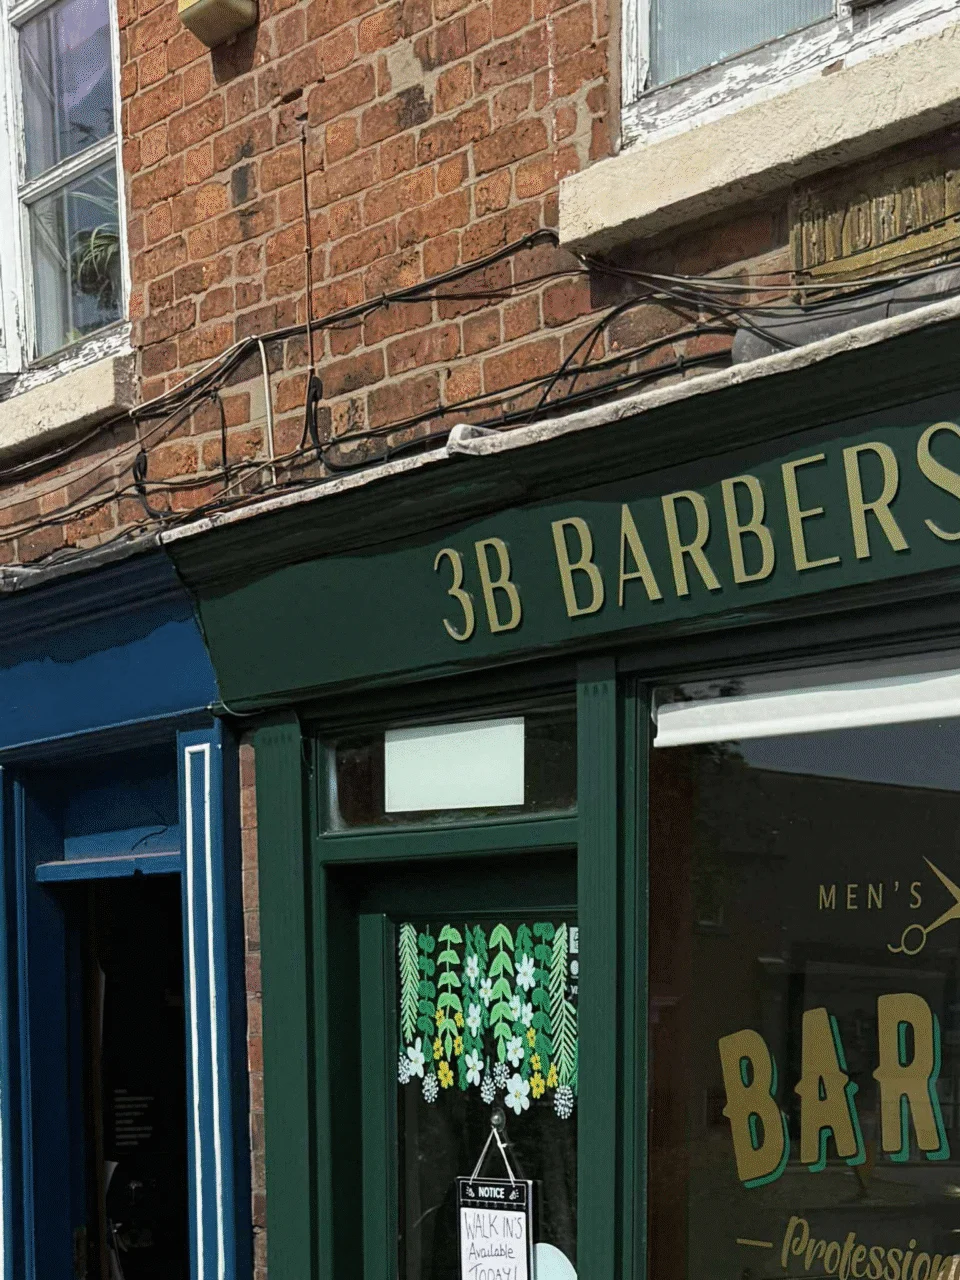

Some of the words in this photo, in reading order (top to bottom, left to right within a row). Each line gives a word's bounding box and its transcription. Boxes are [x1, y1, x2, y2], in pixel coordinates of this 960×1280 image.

[433, 537, 522, 642] 3B
[818, 881, 923, 911] MEN'S
[478, 1186, 505, 1199] NOTICE
[464, 1211, 499, 1241] WALK
[468, 1242, 516, 1261] Available
